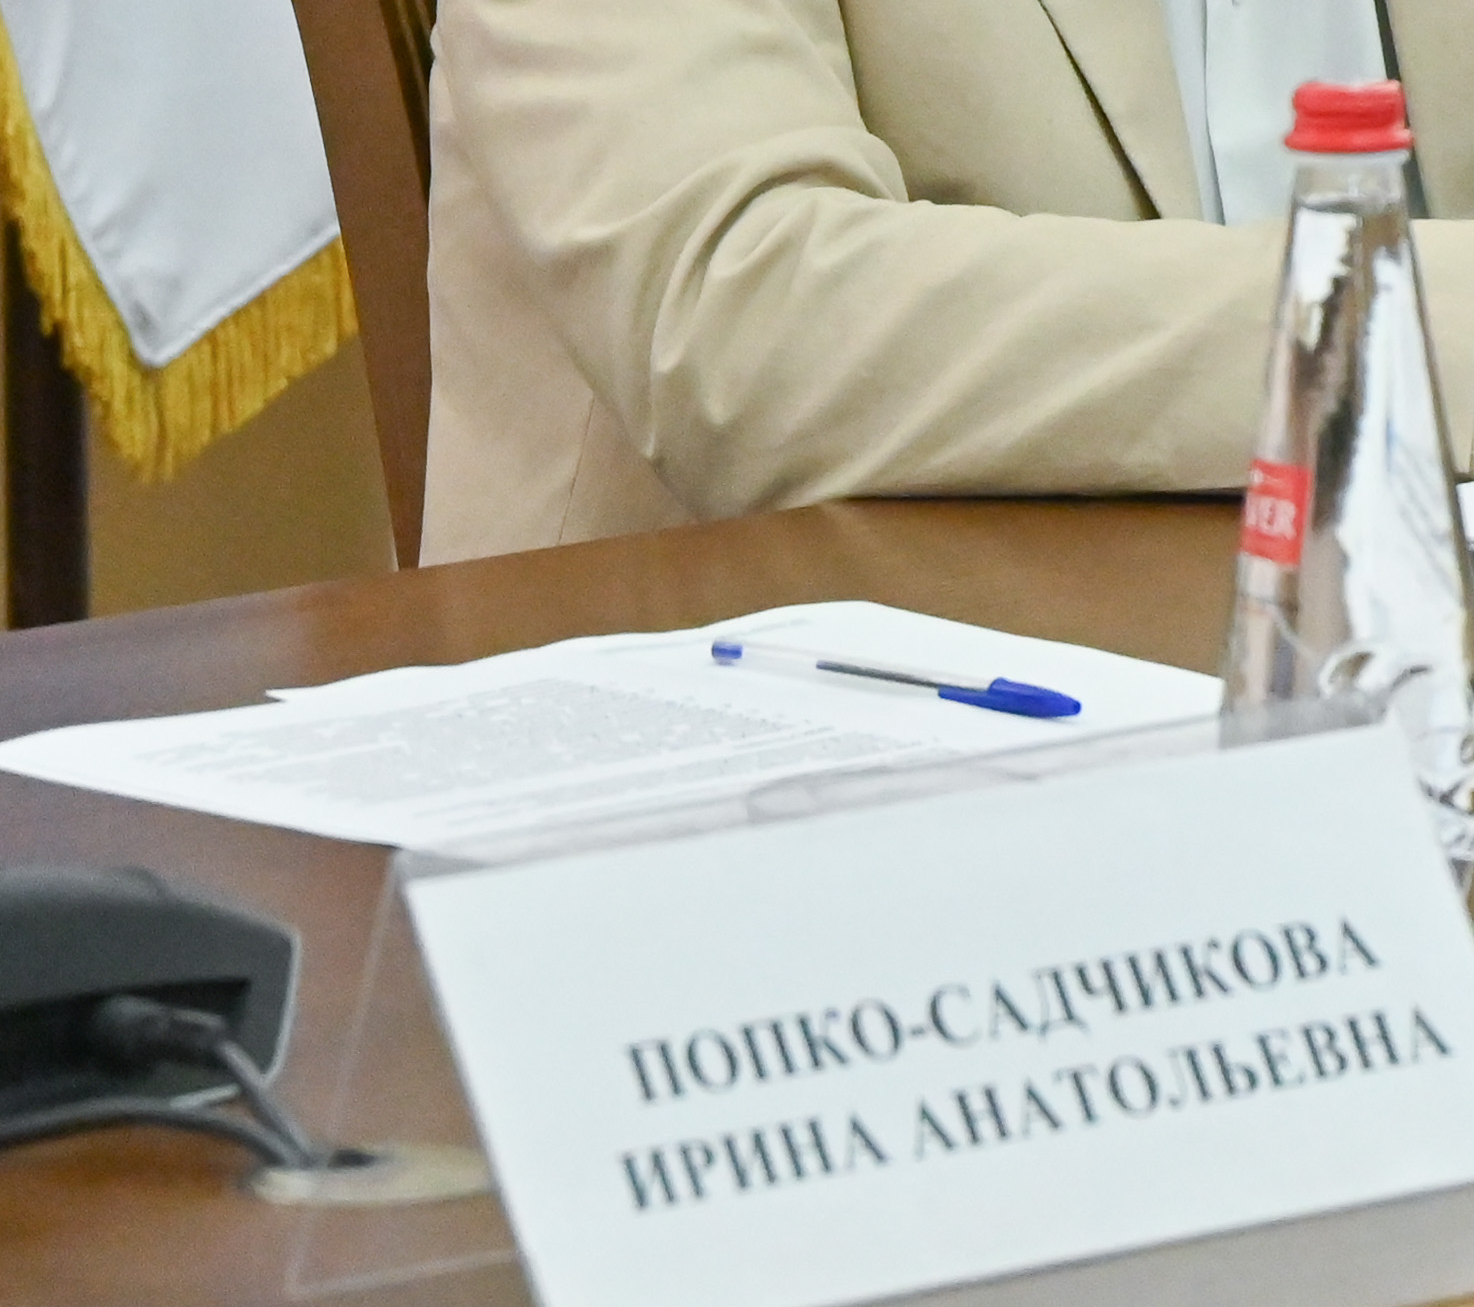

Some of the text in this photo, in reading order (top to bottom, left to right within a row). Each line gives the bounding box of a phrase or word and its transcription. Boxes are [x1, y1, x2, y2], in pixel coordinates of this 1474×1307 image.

[626, 916, 1382, 1104] ПОПКО-САДЧИКОВА
[617, 1006, 1453, 1213] ИРИНА АНАТОЛЬЕВНА
